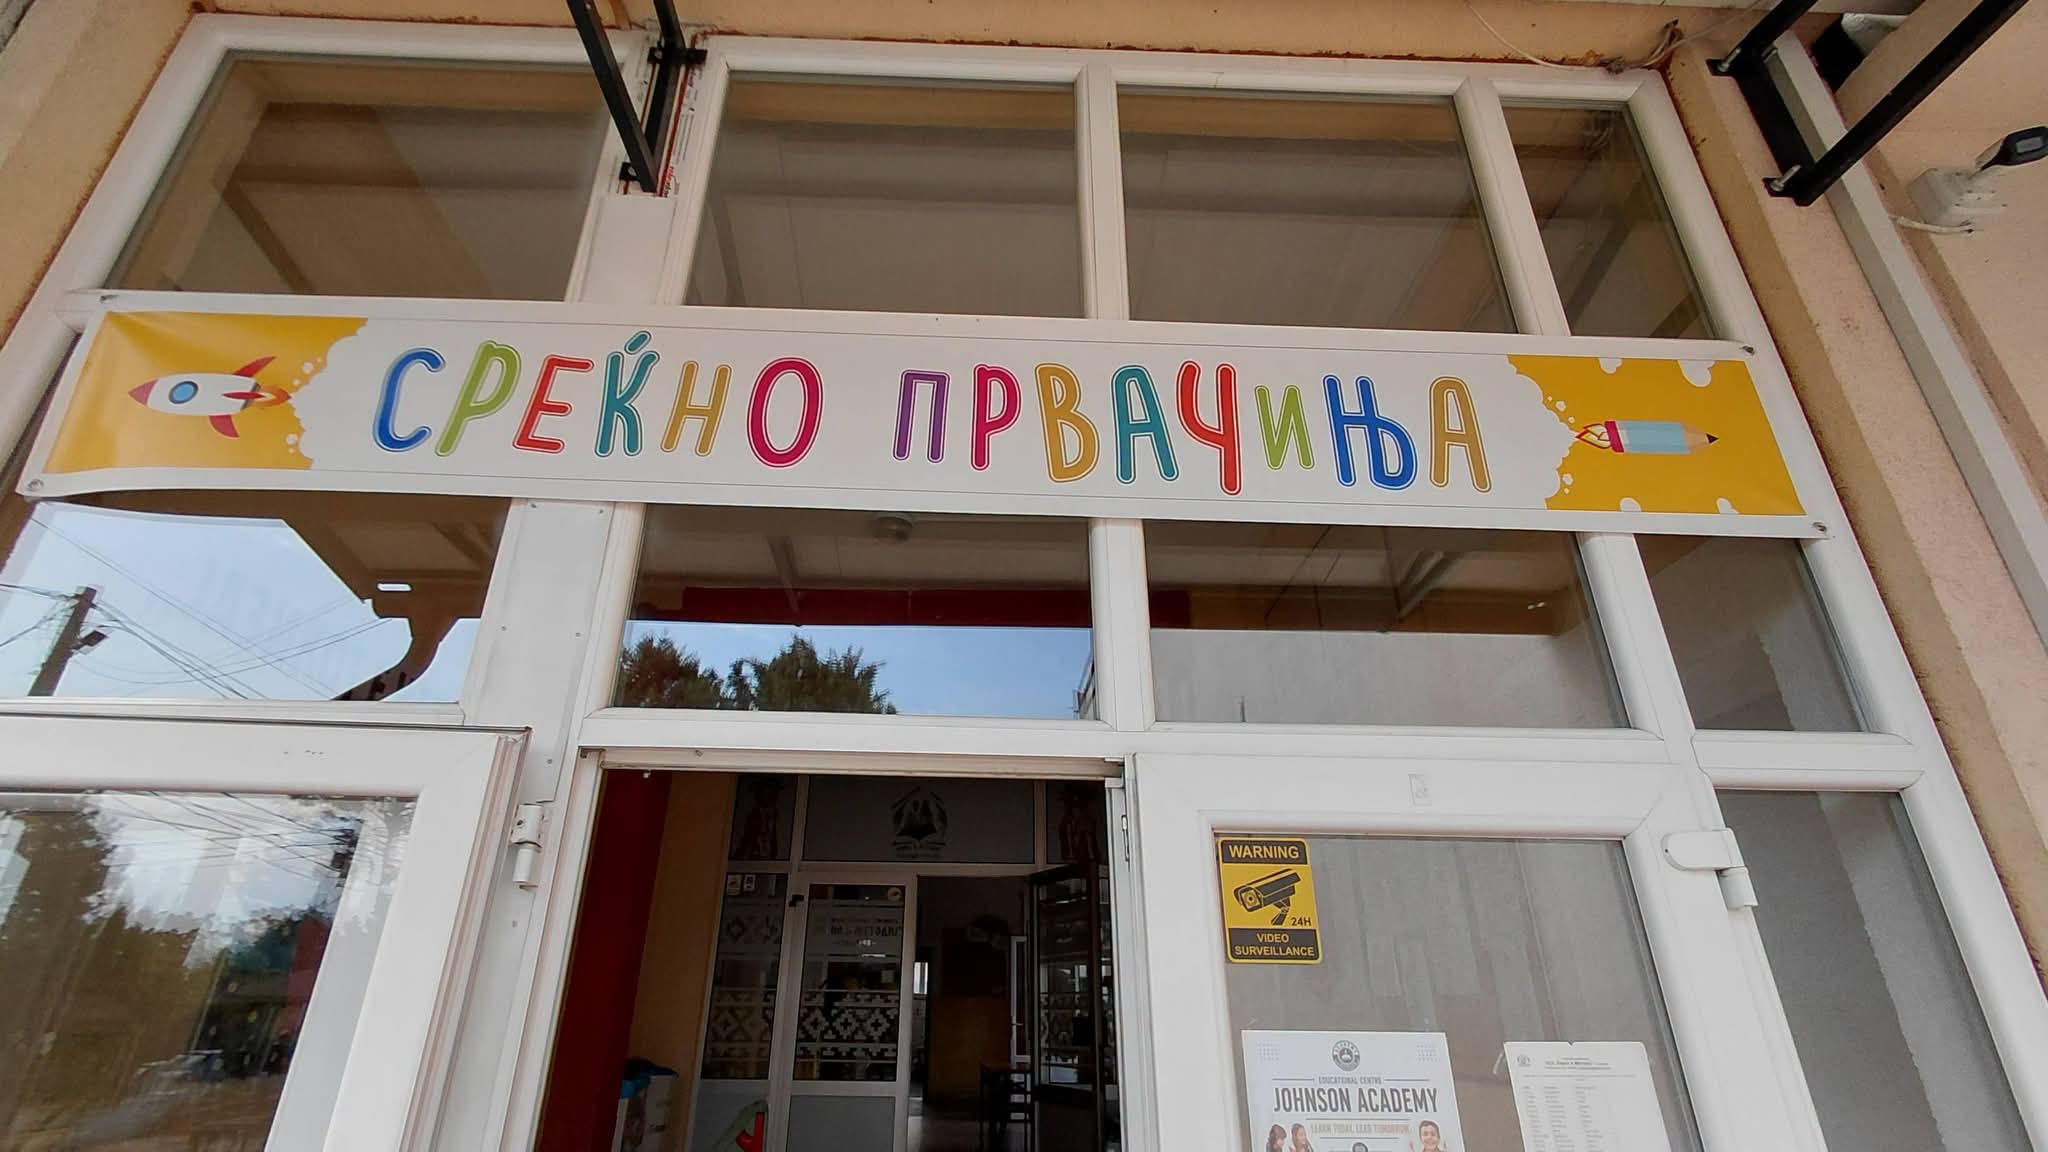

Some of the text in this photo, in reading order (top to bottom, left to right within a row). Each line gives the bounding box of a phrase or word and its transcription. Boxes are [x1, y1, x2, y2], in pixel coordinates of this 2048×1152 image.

[372, 330, 1492, 496] СРЕЌНО ПРВАЧИЊА
[1228, 844, 1299, 859] WARNING
[1291, 917, 1311, 927] 24H
[1256, 933, 1290, 943] VIDEO
[1234, 945, 1315, 957] SURVEILLANCE
[1318, 1076, 1358, 1085] EDUCATIONAL
[1273, 1087, 1438, 1113] JOHNSON ACADEMY
